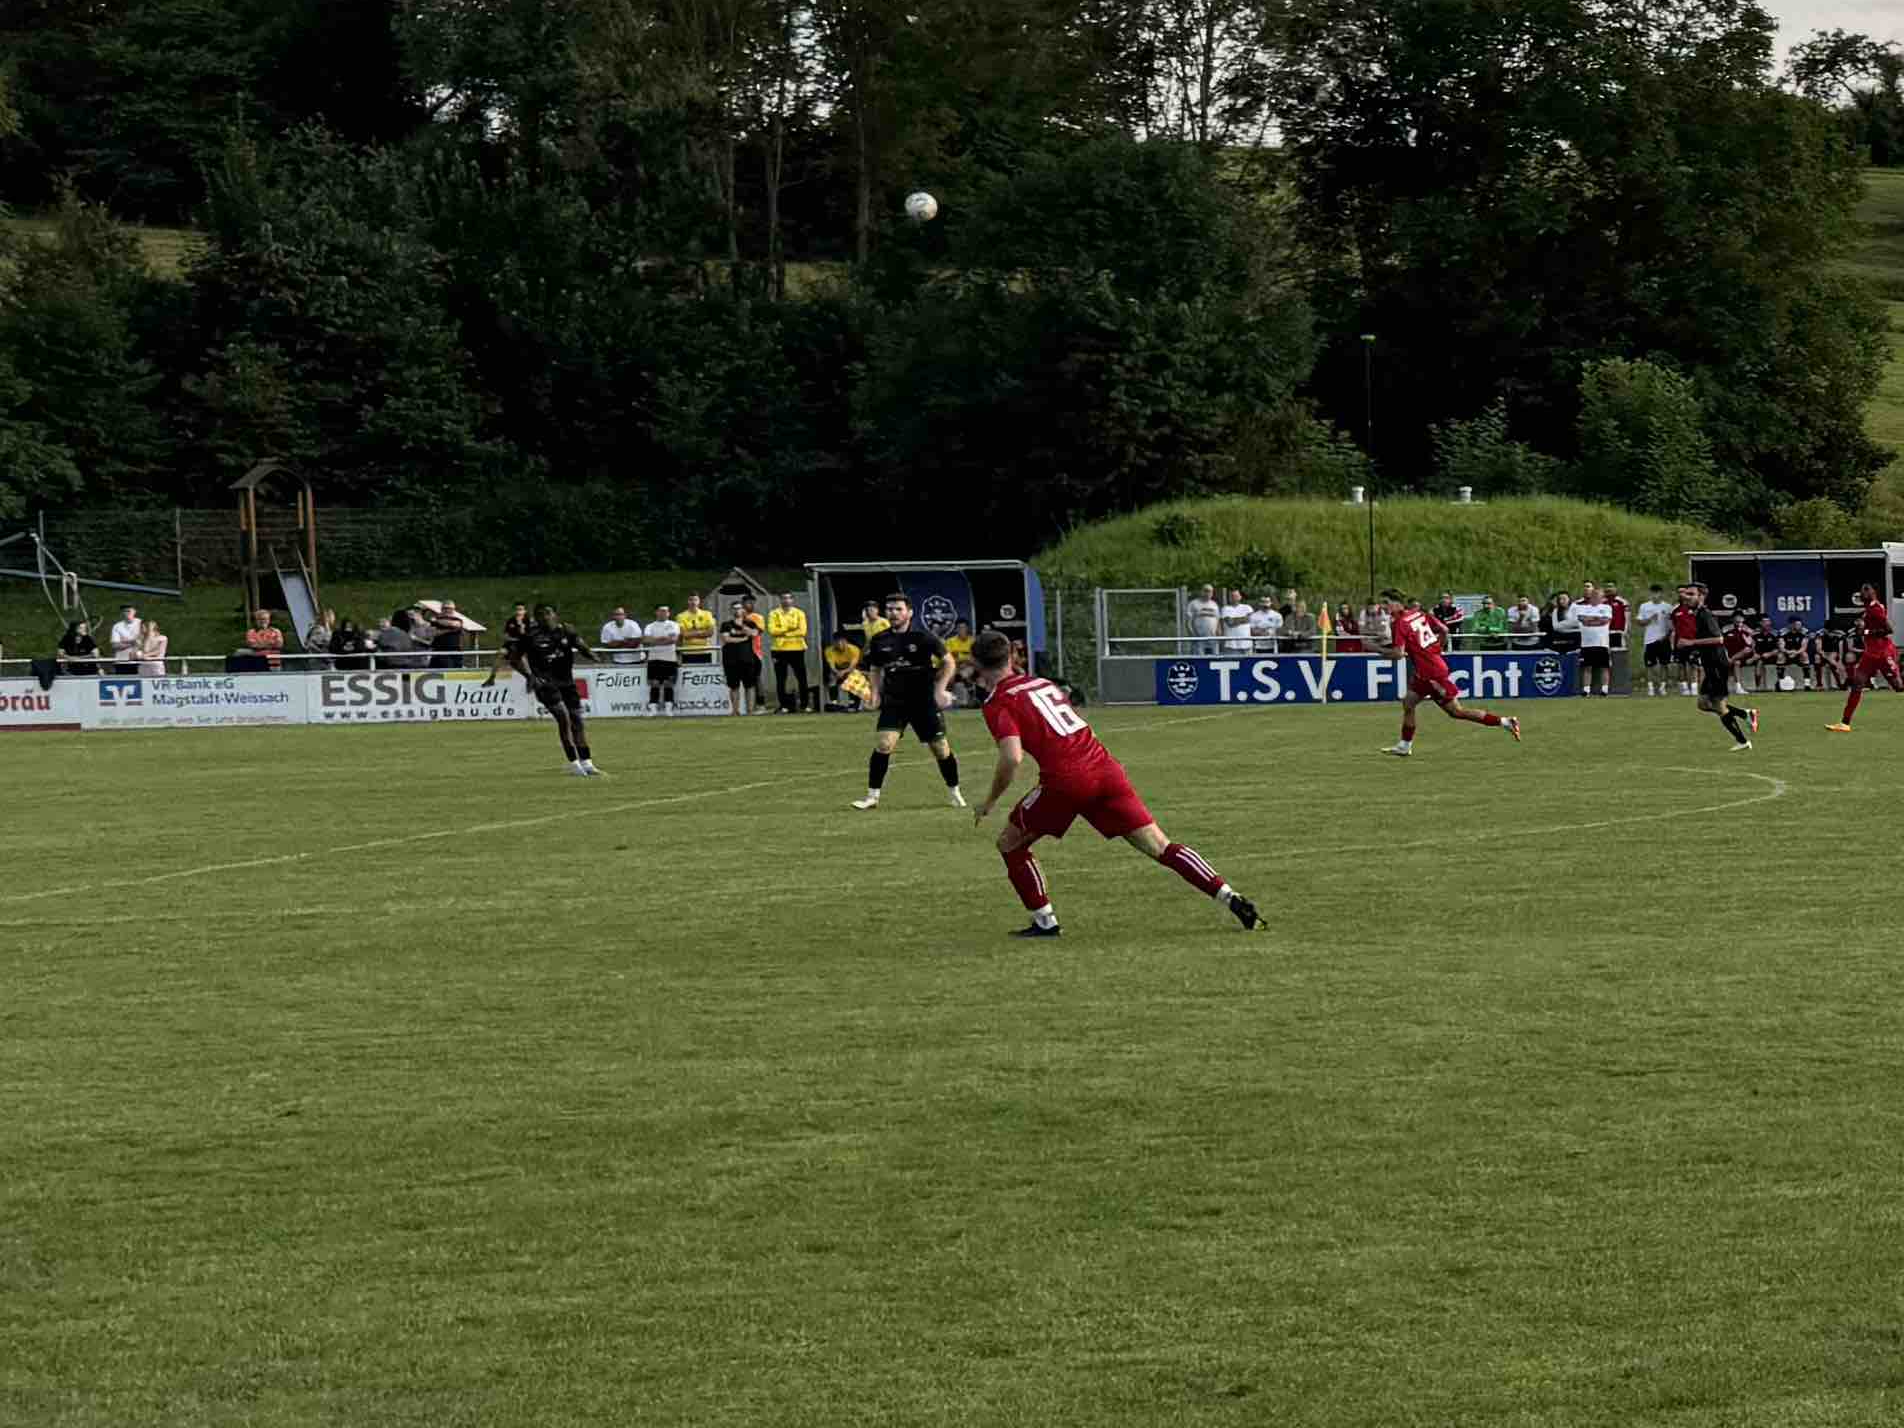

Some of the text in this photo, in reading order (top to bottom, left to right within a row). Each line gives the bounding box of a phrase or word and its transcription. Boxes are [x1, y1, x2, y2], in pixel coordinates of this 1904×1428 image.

[1777, 595, 1812, 612] GAST
[152, 678, 211, 691] VR-Bank
[595, 672, 642, 689] Folien
[1209, 657, 1521, 701] T.S.V. Flcht
[321, 673, 446, 707] ESSIG
[152, 691, 289, 708] Magstadt-Weissach
[1028, 684, 1089, 737] 16
